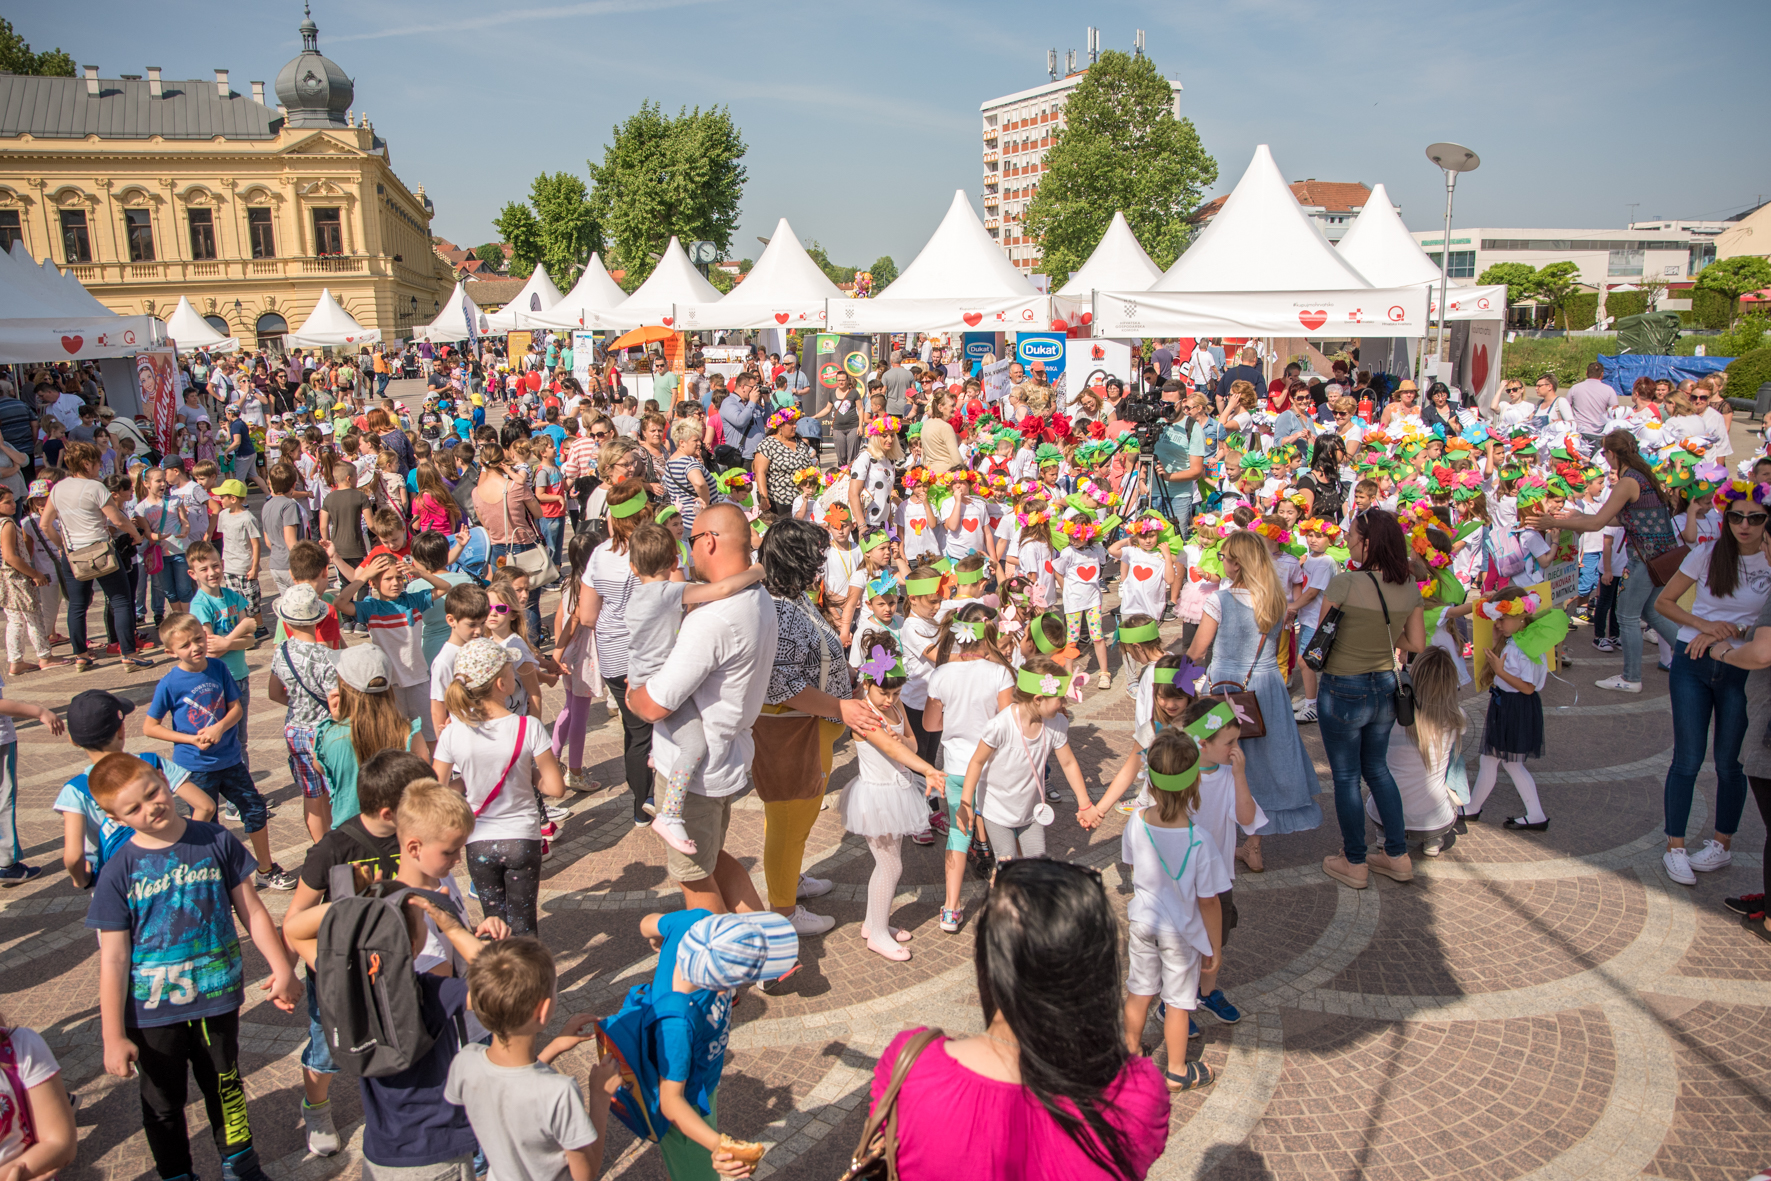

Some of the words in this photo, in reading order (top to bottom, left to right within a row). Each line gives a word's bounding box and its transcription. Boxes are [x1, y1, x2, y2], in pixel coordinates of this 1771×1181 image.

[1025, 345, 1058, 355] Dukat
[1563, 563, 1577, 575] VRTIĆ
[140, 962, 198, 1009] 75
